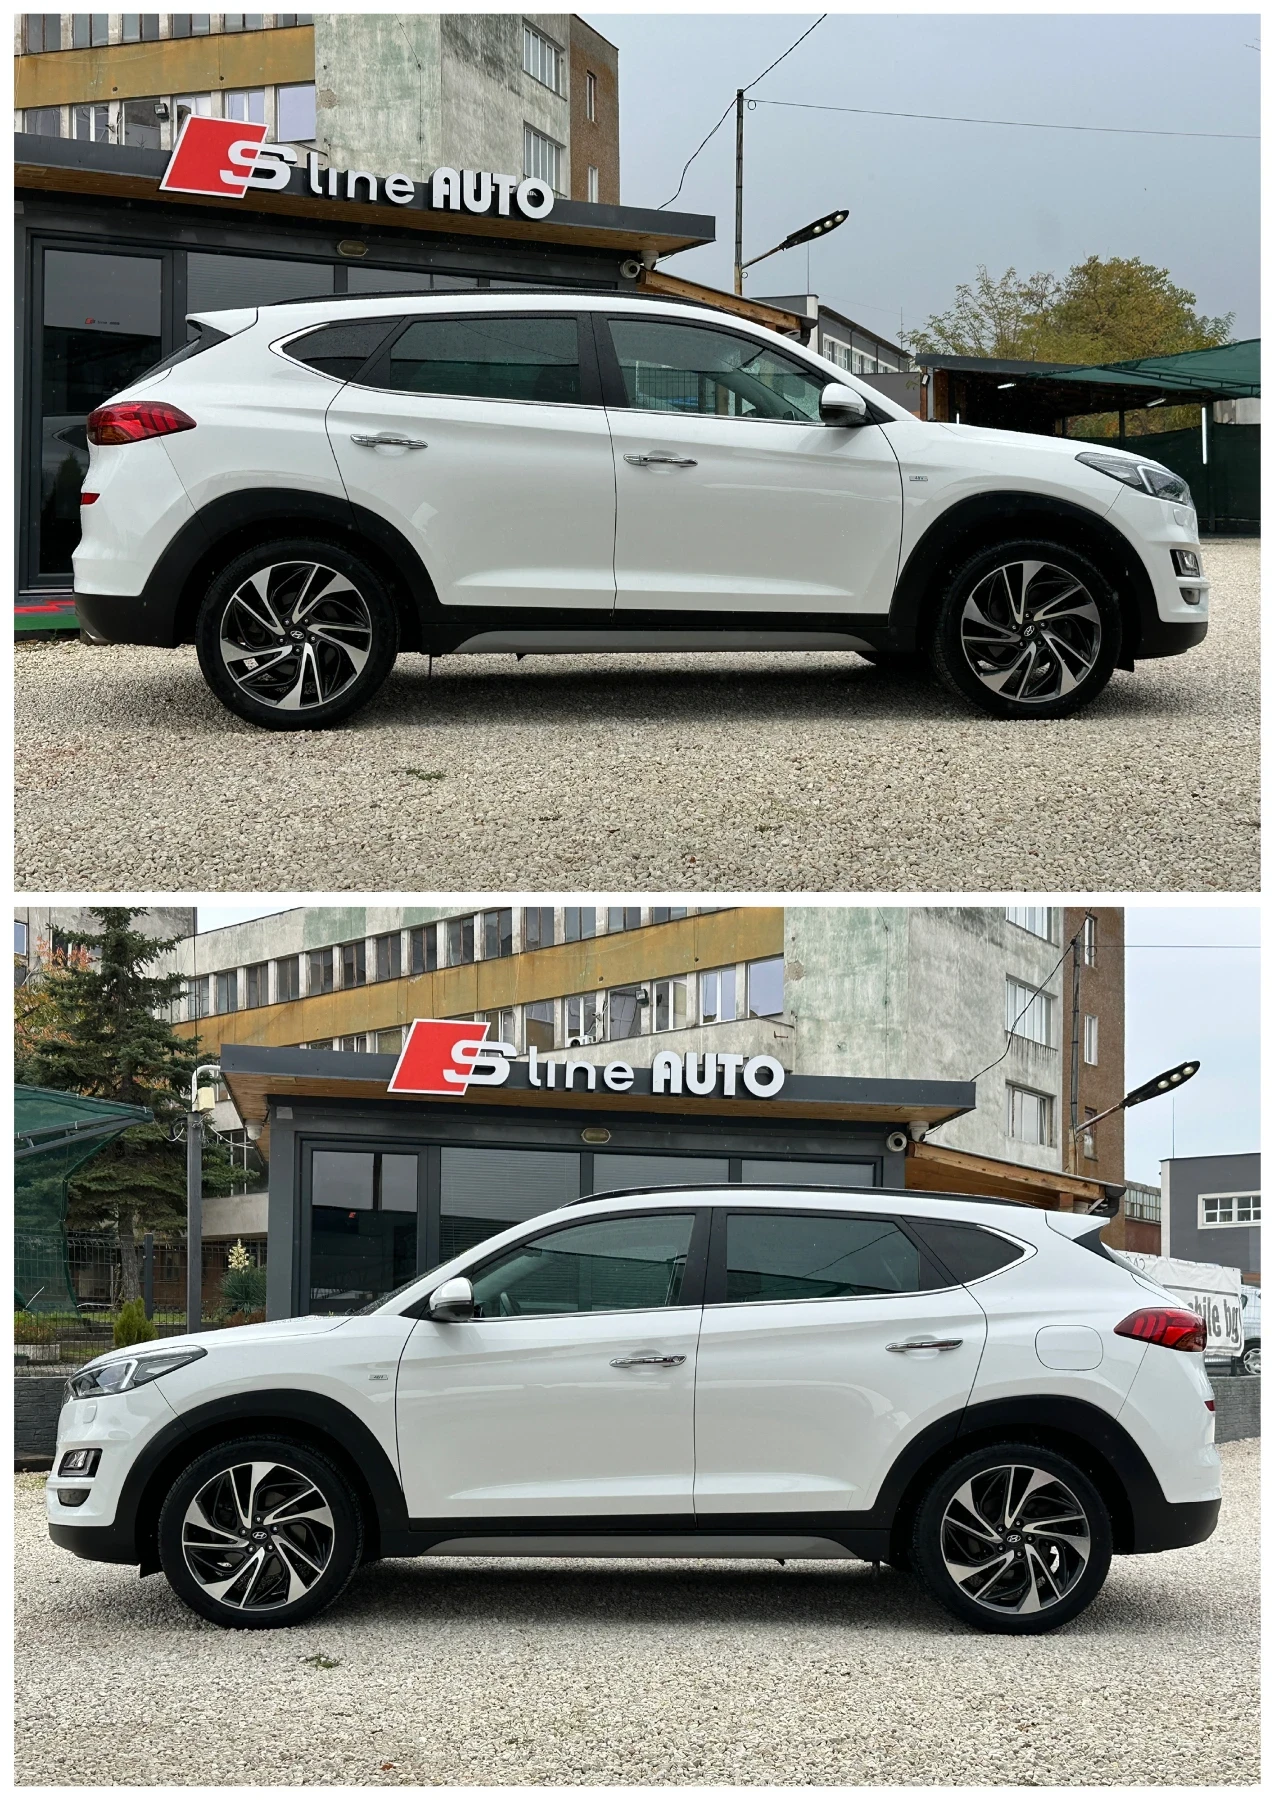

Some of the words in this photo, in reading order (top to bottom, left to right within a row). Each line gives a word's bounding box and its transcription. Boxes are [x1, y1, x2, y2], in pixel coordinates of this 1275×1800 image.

[219, 140, 298, 190] S
[308, 151, 415, 204] line
[432, 166, 555, 219] AUTO
[442, 1039, 518, 1086] S
[528, 1045, 634, 1091] line
[652, 1050, 785, 1098] AUTO
[1223, 1298, 1240, 1344] bg
